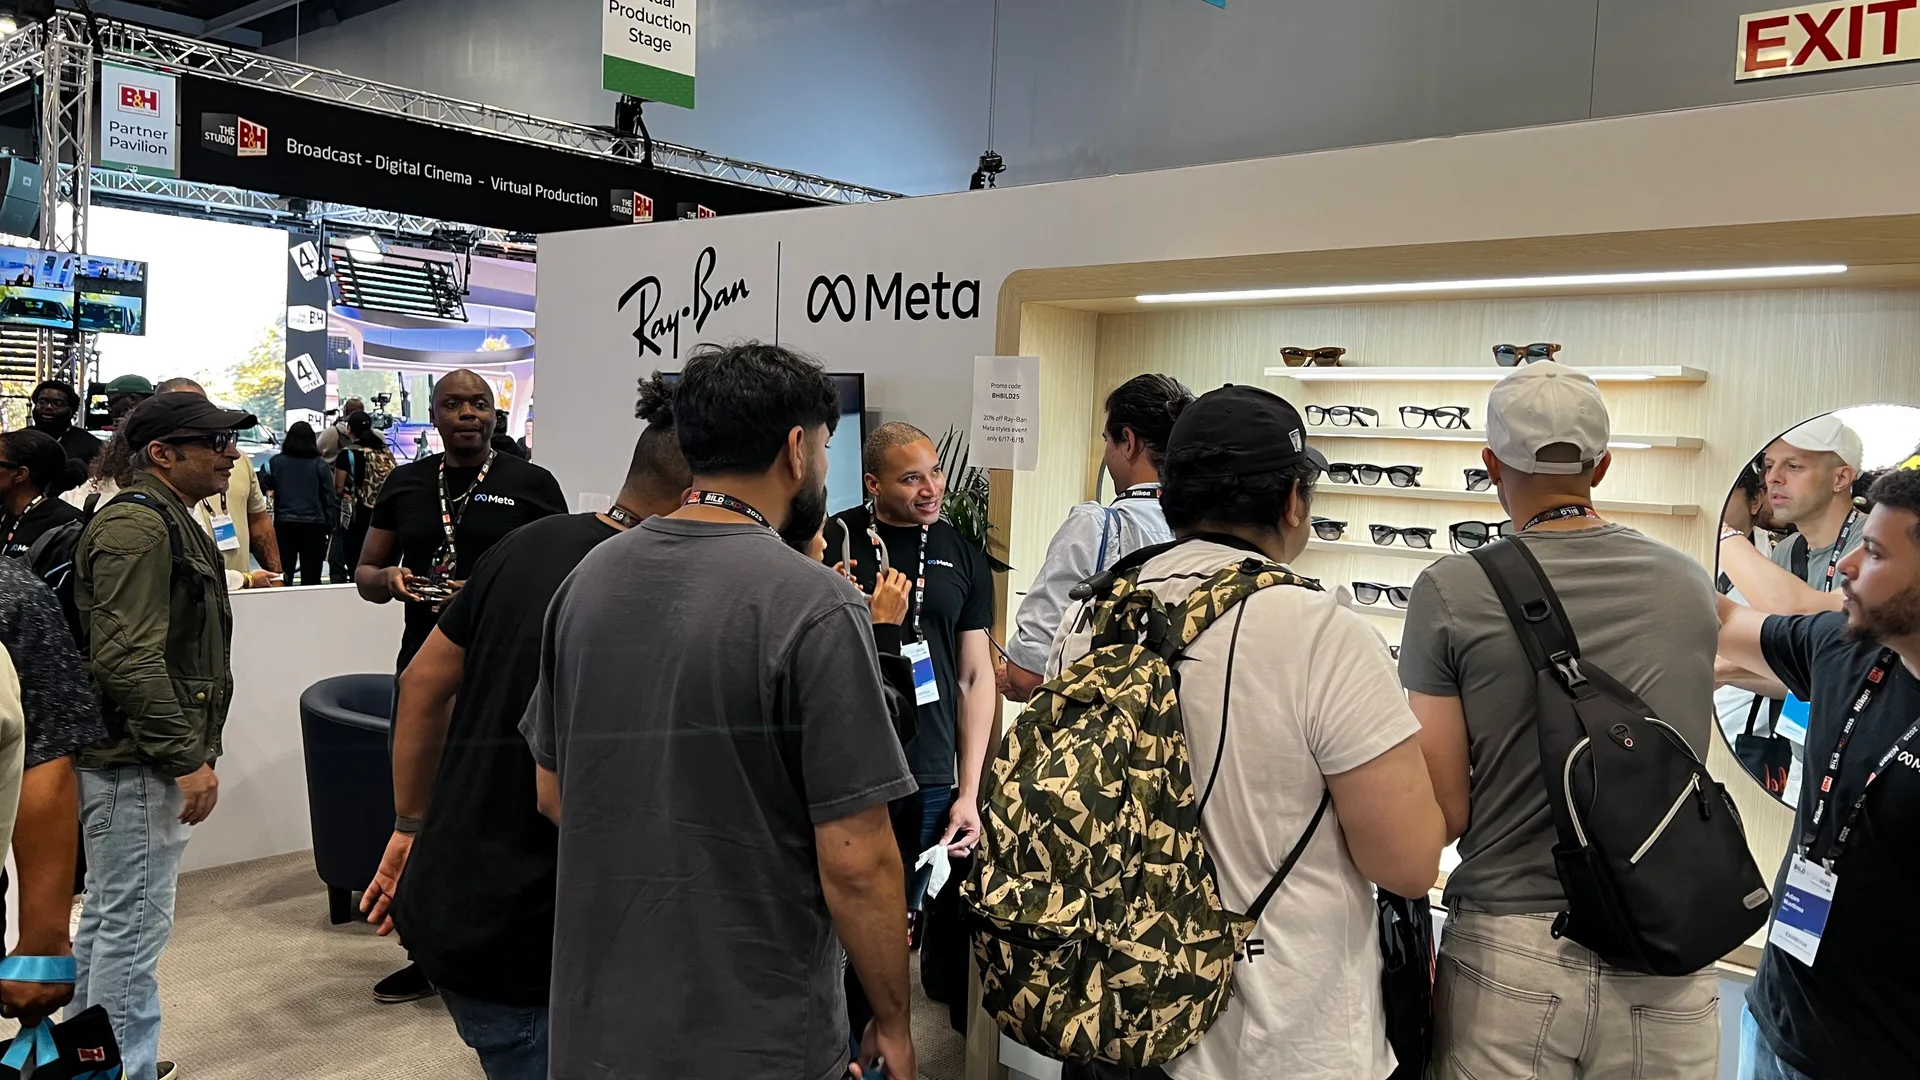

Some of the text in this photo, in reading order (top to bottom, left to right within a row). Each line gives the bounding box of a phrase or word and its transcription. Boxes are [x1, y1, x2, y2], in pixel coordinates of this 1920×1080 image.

[609, 0, 691, 35] Production
[628, 27, 672, 52] Stage
[1744, 0, 1917, 72] EXIT
[121, 85, 157, 111] B&H
[109, 120, 168, 140] Partner
[204, 131, 236, 146] STUDIO
[219, 125, 236, 137] THE
[239, 121, 266, 149] B&H
[110, 136, 168, 155] Pavilion
[286, 138, 362, 166] Broadcast
[375, 154, 421, 175] Digital
[424, 164, 472, 185] Cinema
[491, 176, 532, 196] Virtual
[535, 184, 598, 207] Production
[612, 205, 633, 215] STUDIO
[621, 199, 633, 208] THE
[635, 194, 652, 217] B&H
[299, 247, 315, 269] 4
[865, 271, 980, 322] Meta
[297, 360, 313, 381] 4
[996, 425, 1011, 433] styles
[1004, 415, 1027, 423] Ray-Ban
[488, 494, 515, 506] Meta
[746, 508, 763, 522] 2025
[1854, 689, 1871, 712] Nikon
[1843, 717, 1855, 734] 2025
[1879, 745, 1900, 767] Nikon
[1813, 799, 1825, 825] Nikon
